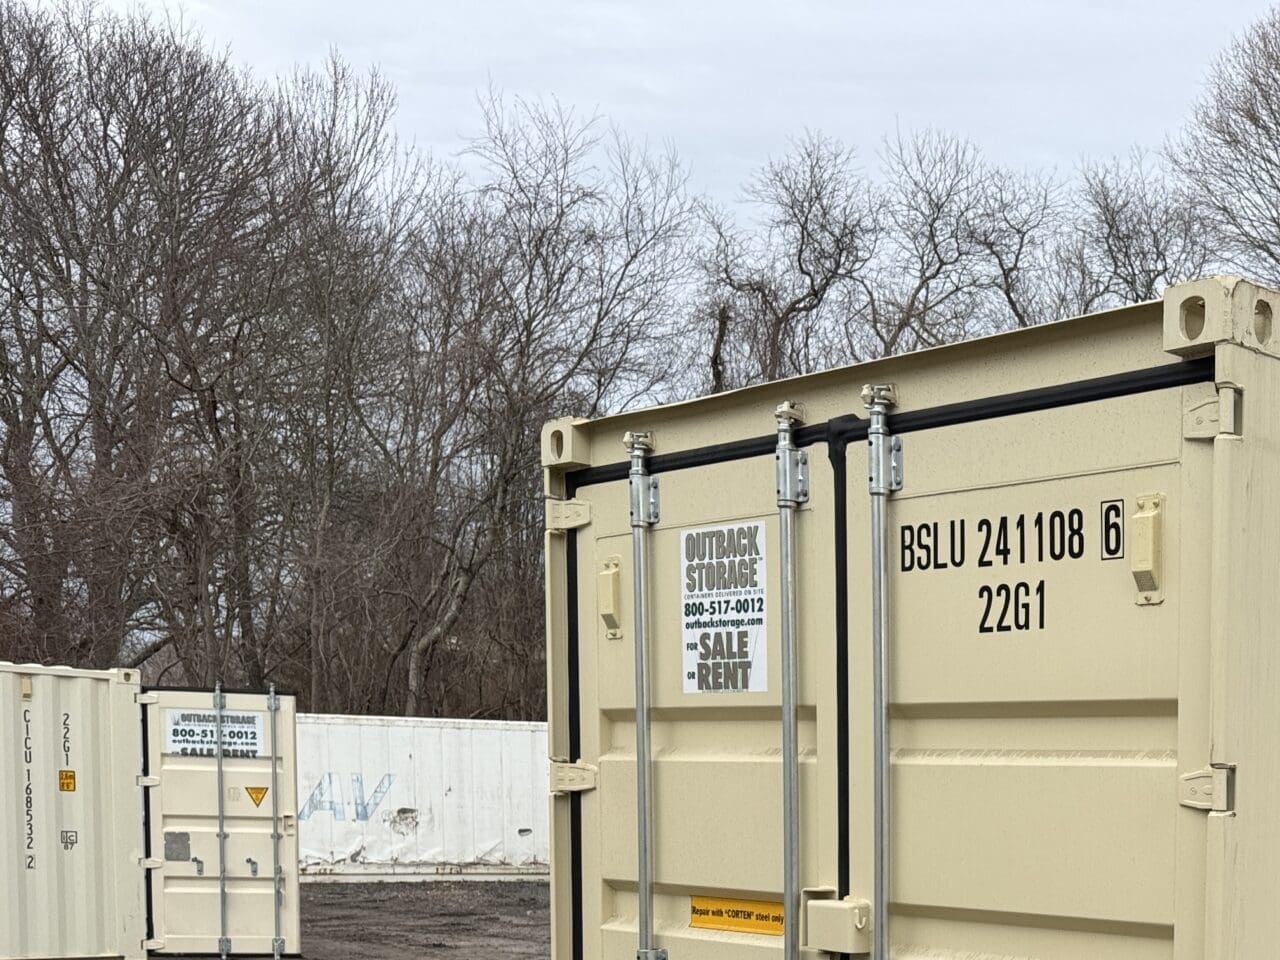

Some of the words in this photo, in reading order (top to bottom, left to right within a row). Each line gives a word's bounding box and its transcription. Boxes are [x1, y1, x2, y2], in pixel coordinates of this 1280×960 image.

[685, 525, 760, 562] OUTBACK
[900, 518, 966, 572] BSLU
[977, 508, 1085, 568] 241108
[1103, 503, 1122, 556] 6
[685, 557, 758, 593] STORAGE
[684, 597, 764, 617] 800-517-0012
[685, 617, 763, 630] outbackstorage.com
[978, 579, 1045, 634] 22G1
[686, 642, 698, 651] FOR
[699, 630, 749, 661] SALE
[687, 672, 696, 680] OR
[697, 660, 752, 691] RENT
[23, 709, 32, 764] CICU
[25, 767, 34, 850] 168532
[691, 905, 710, 917] Repair
[711, 908, 724, 917] with
[755, 912, 770, 922] steel
[771, 914, 785, 925] only
